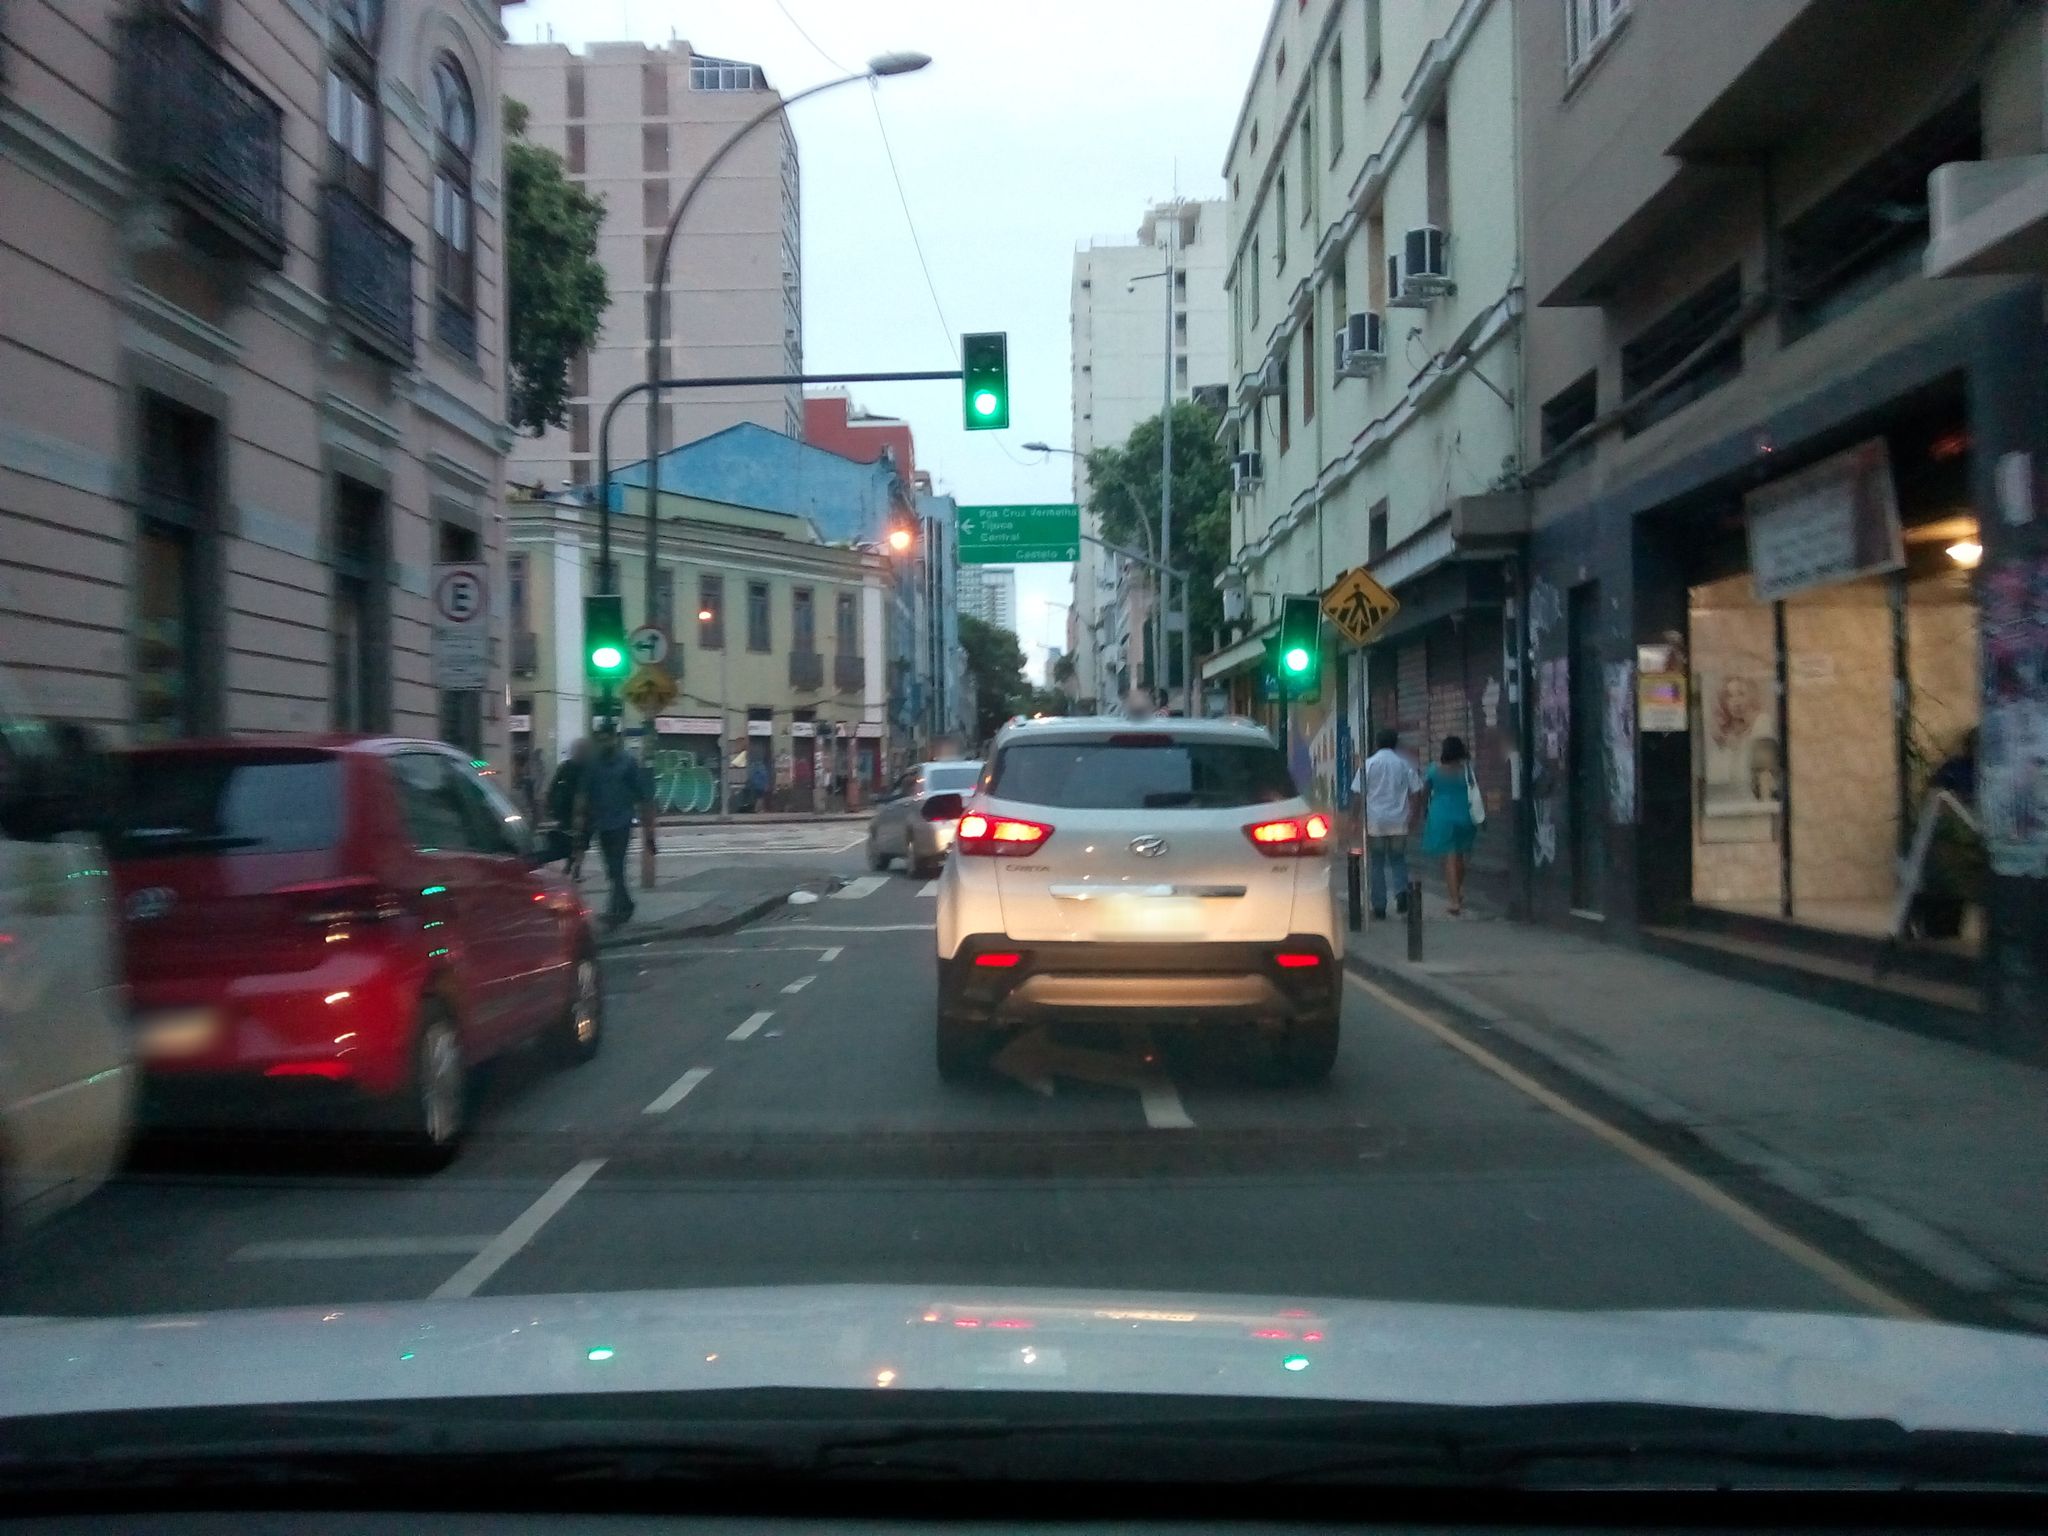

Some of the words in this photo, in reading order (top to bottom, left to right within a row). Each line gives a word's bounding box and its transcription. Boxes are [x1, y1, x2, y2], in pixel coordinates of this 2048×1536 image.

[1002, 508, 1026, 518] Cruz
[1030, 507, 1077, 517] Vermelha
[981, 520, 1013, 531] Tijuca
[980, 532, 1020, 542] Central
[1015, 549, 1058, 559] Castelo
[452, 582, 471, 611] E
